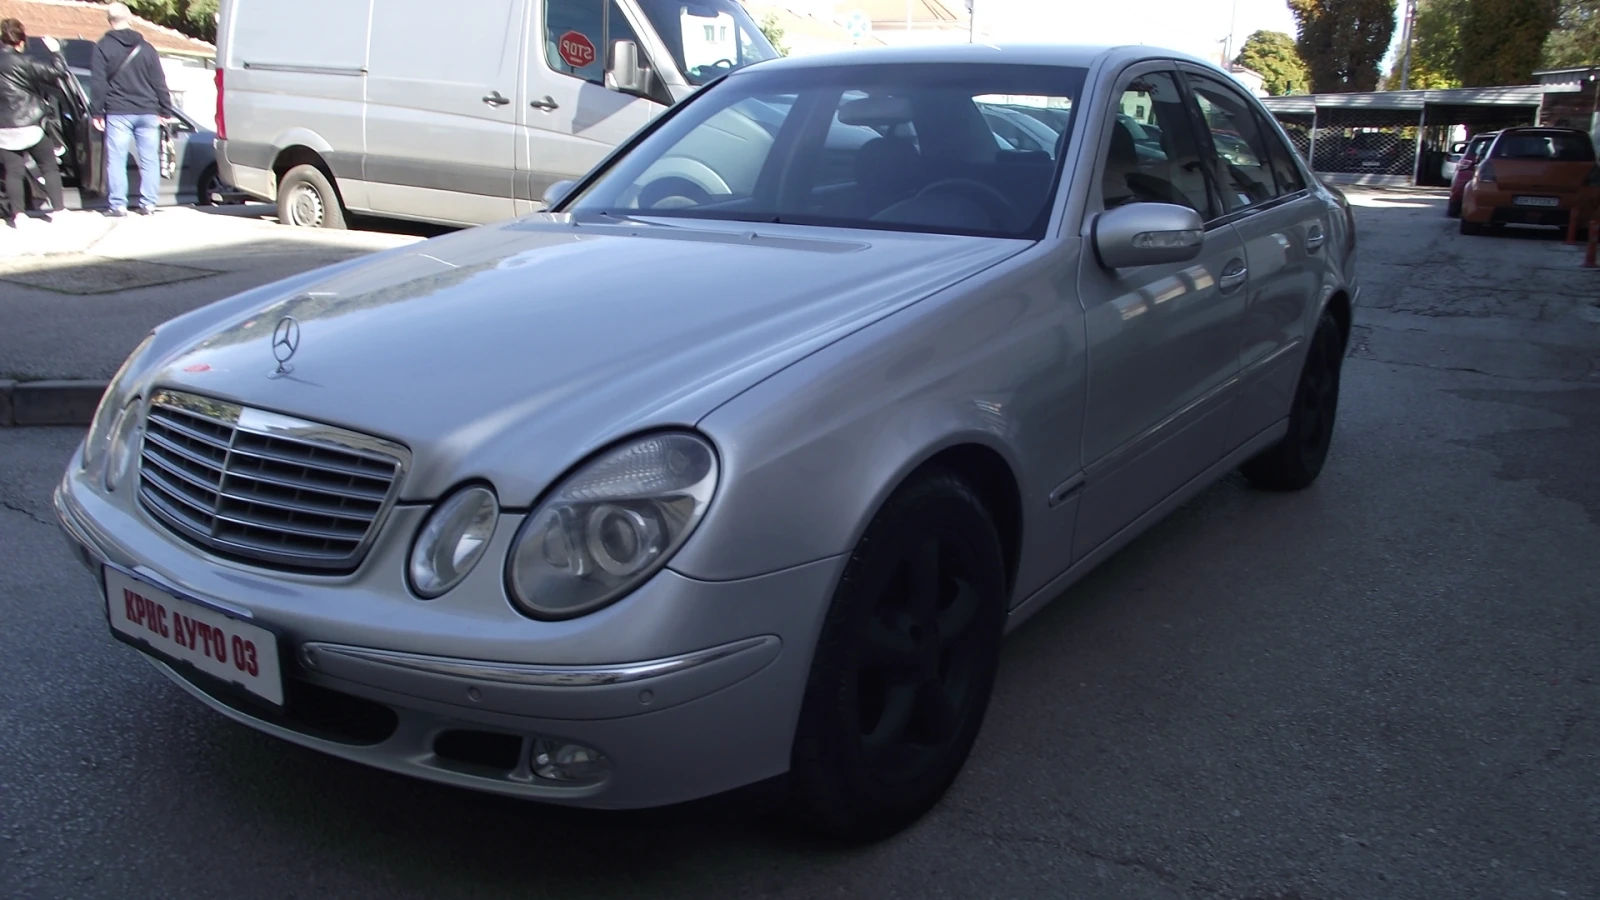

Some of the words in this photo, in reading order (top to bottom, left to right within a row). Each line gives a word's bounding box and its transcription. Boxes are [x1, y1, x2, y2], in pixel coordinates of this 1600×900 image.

[123, 588, 169, 638] КРИС
[173, 611, 227, 664] АУТО
[231, 634, 259, 677] 03
